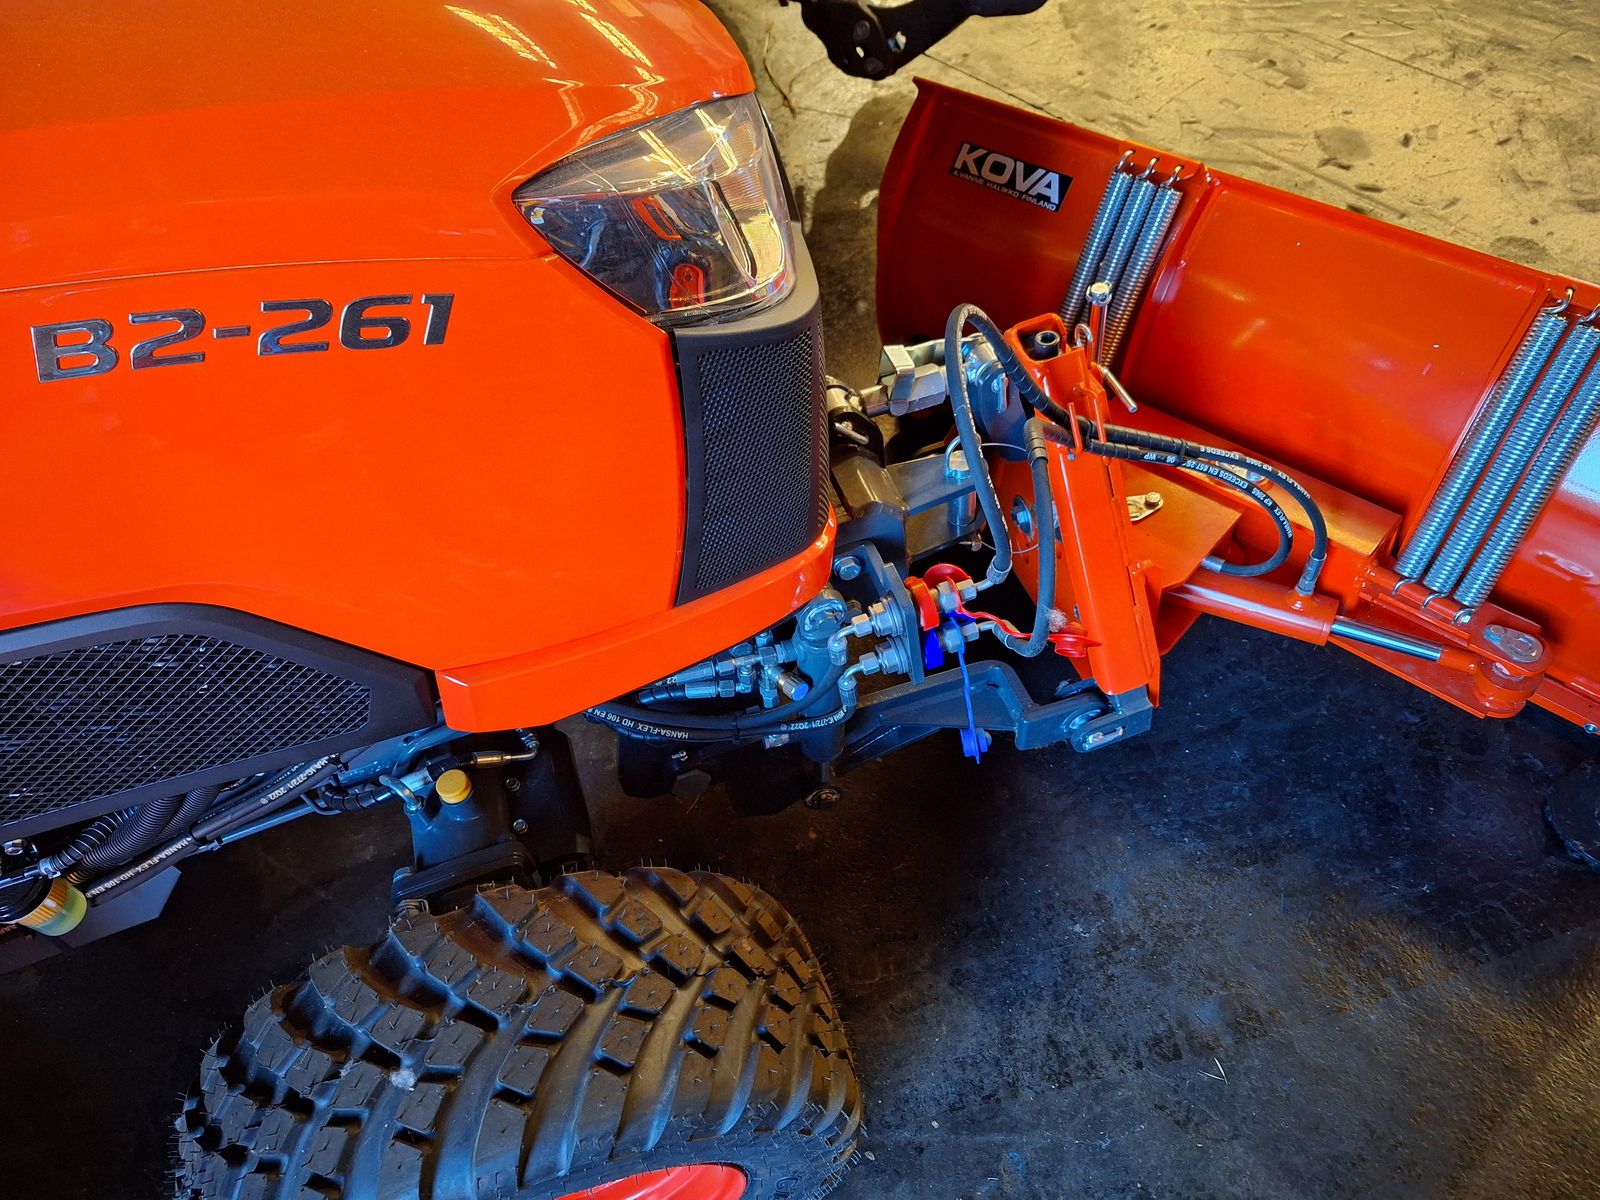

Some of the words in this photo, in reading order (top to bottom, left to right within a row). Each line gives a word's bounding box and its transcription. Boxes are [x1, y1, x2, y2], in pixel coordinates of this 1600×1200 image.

[953, 143, 1060, 205] KOVA
[30, 293, 455, 383] B2-261
[1207, 466, 1219, 476] EN
[1218, 471, 1249, 489] EXCEEDS
[593, 708, 606, 718] EN
[607, 712, 620, 723] 106
[622, 718, 634, 728] HD
[637, 722, 688, 739] HANSA-FLEX
[790, 721, 809, 731] 2022
[268, 786, 288, 802] 2022
[136, 837, 189, 873] HANSA-FLEX
[92, 883, 107, 897] EN
